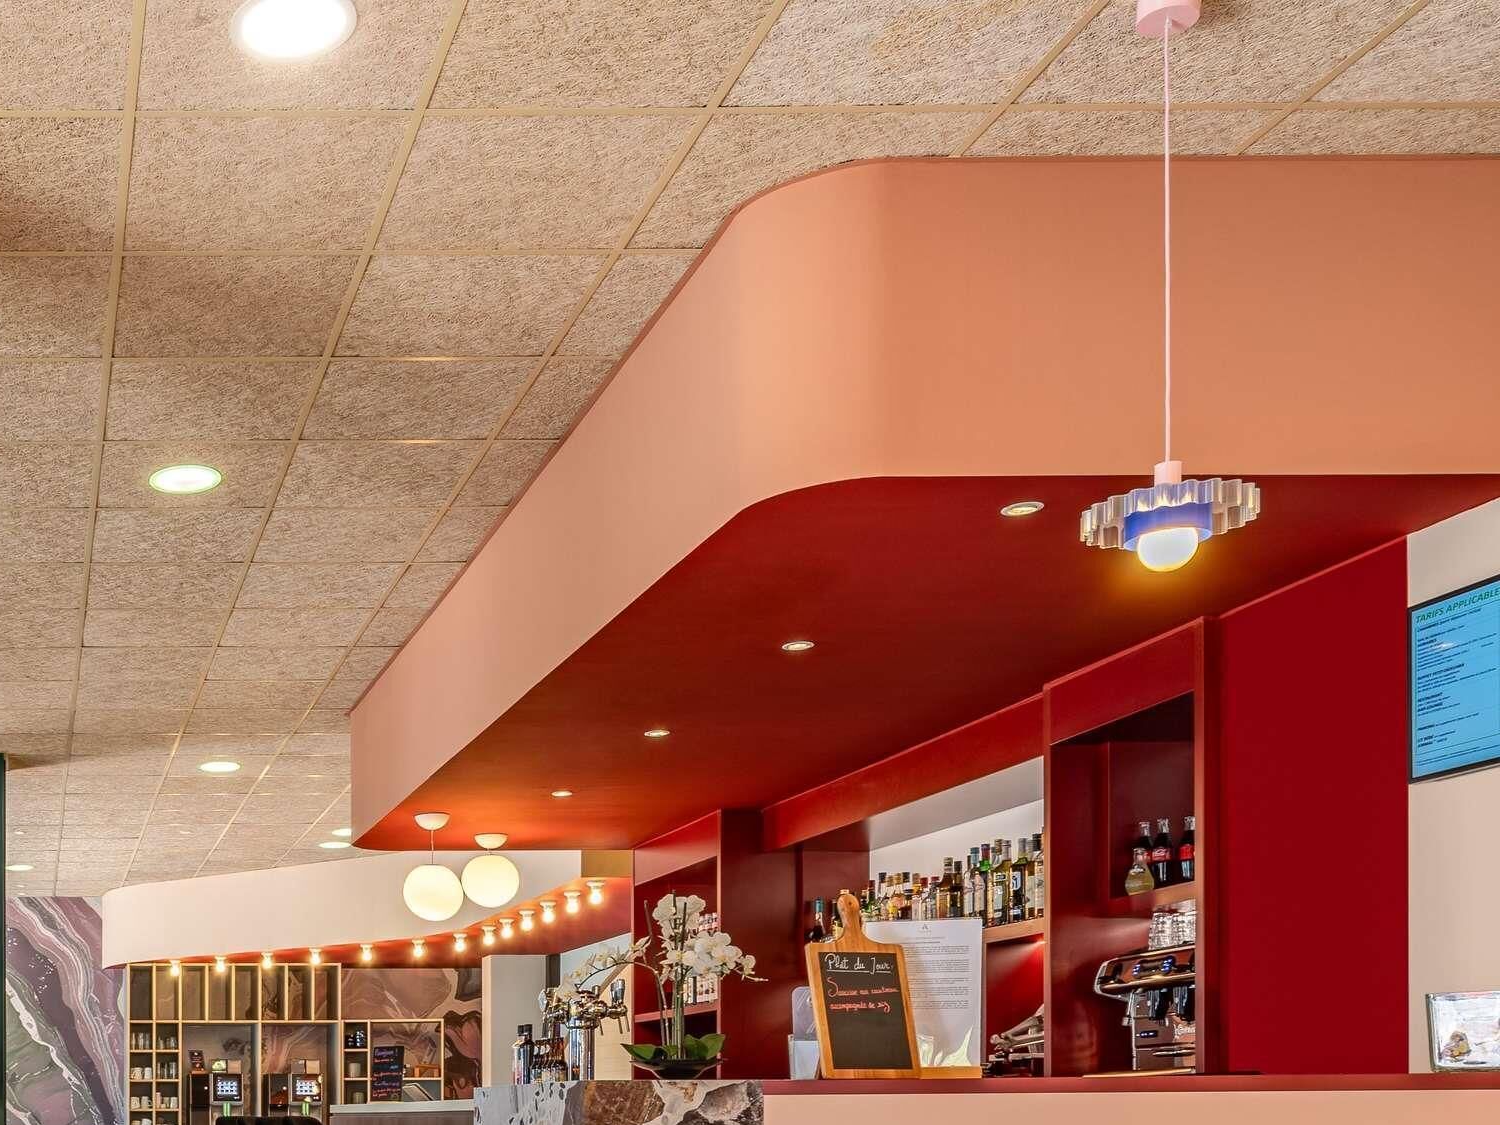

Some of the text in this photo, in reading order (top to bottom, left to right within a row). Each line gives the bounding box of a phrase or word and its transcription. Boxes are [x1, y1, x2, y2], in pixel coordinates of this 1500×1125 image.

[1416, 606, 1445, 624] TARIFS
[825, 953, 849, 970] Plat
[854, 957, 866, 970] du
